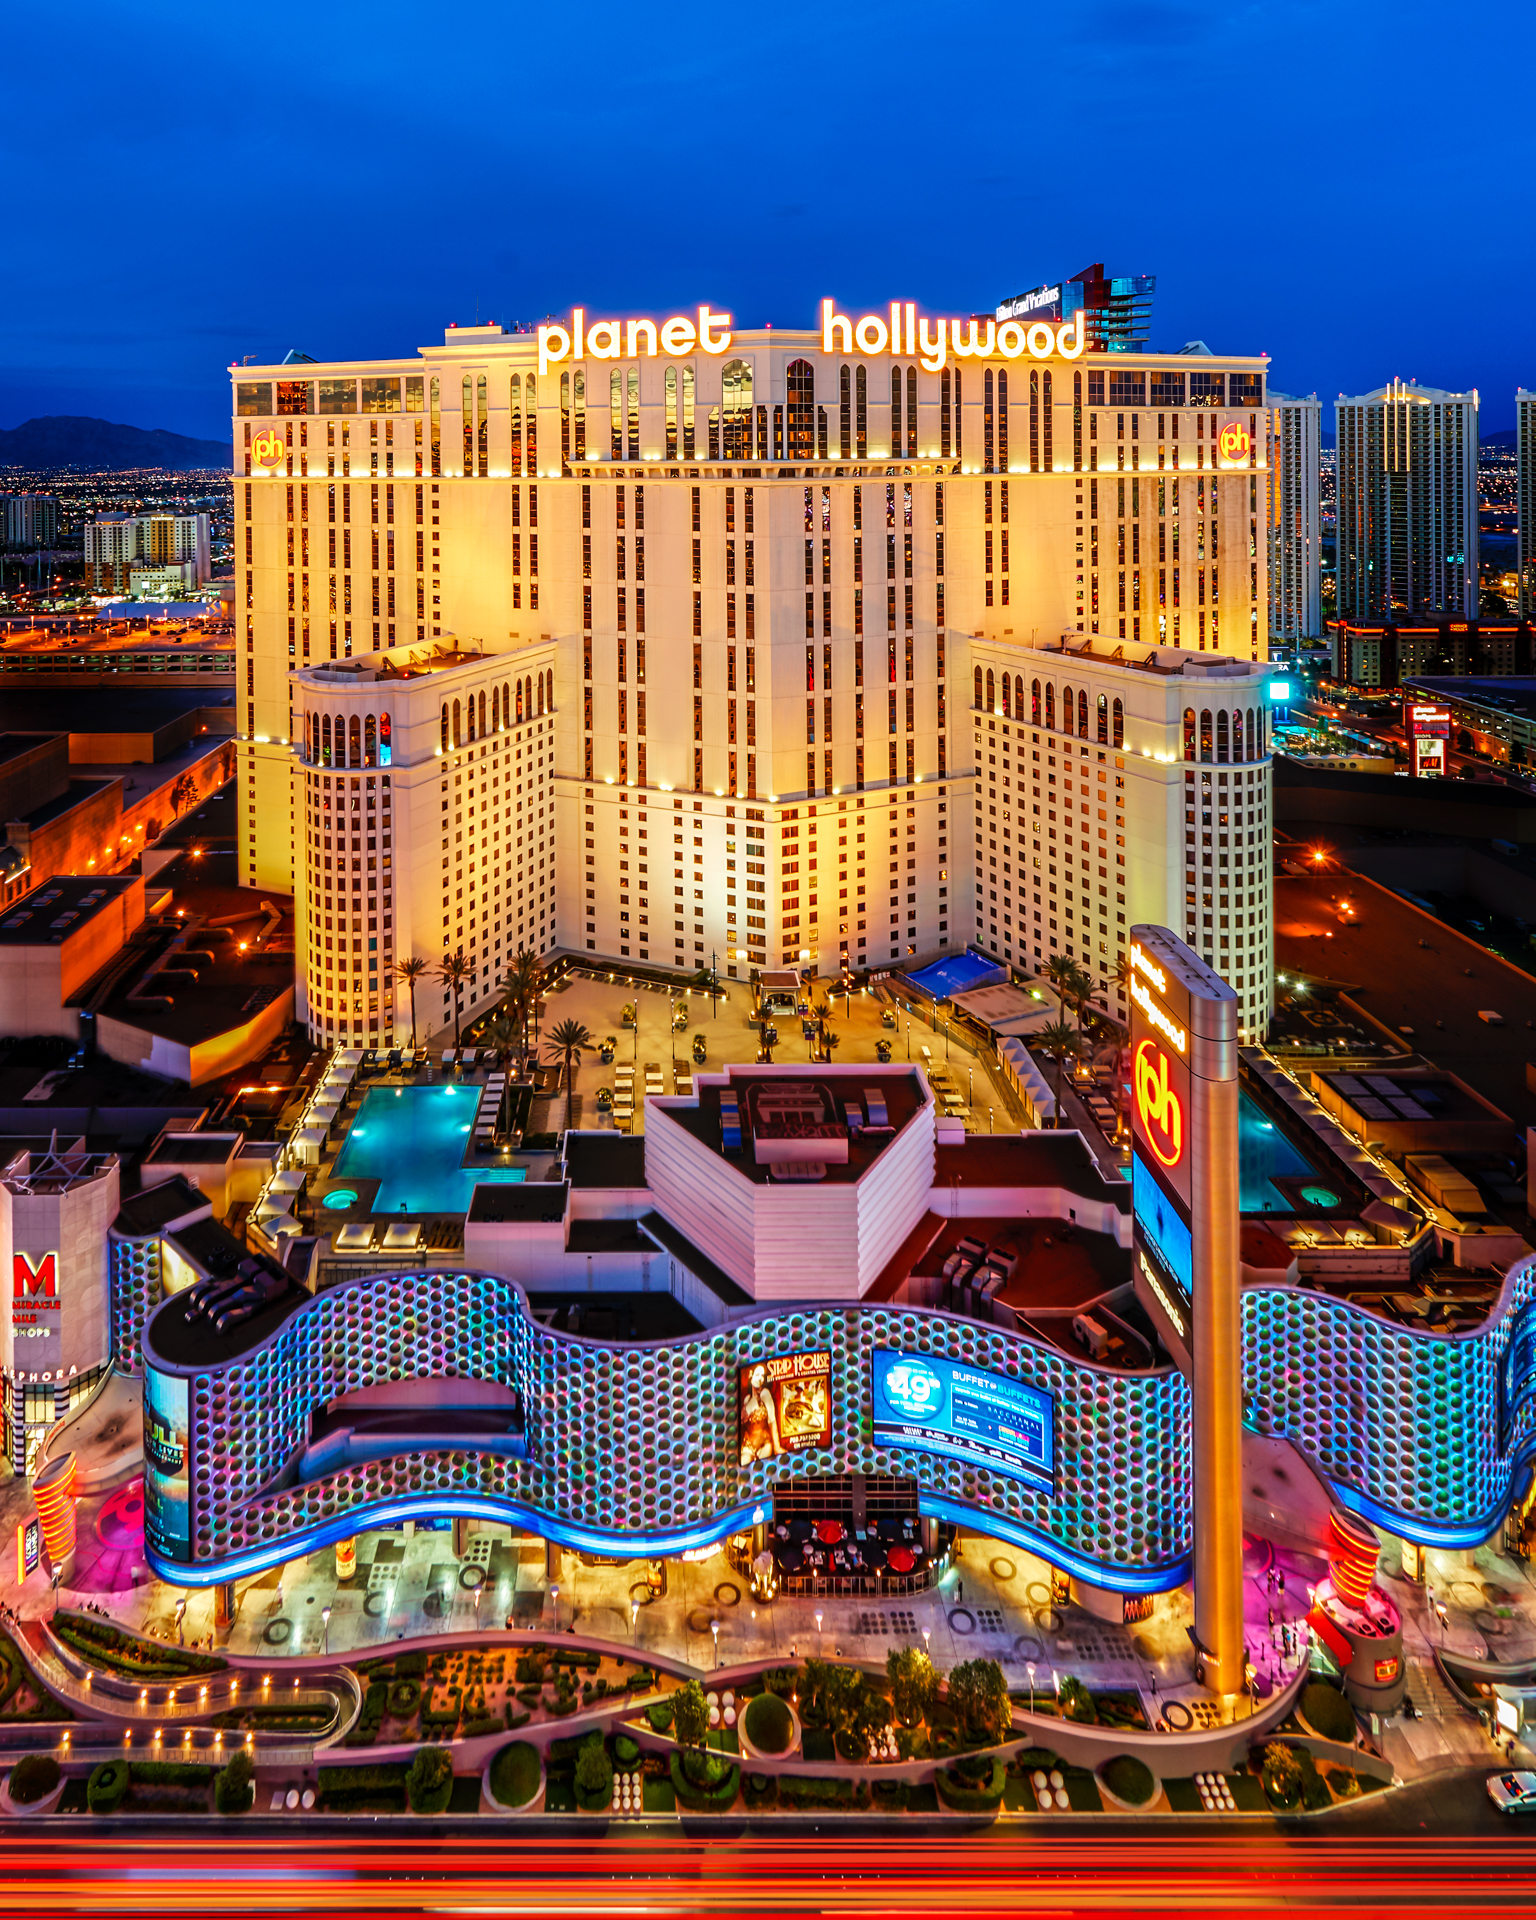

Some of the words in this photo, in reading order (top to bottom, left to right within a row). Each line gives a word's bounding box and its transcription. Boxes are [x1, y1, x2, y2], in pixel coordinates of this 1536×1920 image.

[996, 304, 1012, 323] Hilton
[1012, 294, 1029, 316] Grand
[1029, 286, 1059, 310] Vacations
[538, 306, 732, 376] planet
[823, 299, 1085, 372] hollywood
[254, 430, 283, 464] ph
[1222, 423, 1249, 458] ph
[1131, 973, 1185, 1052] hollywood
[1139, 1046, 1181, 1155] ph
[14, 1252, 59, 1297] M
[12, 1301, 61, 1310] MIRACLE
[1140, 1252, 1184, 1338] Panasonic
[12, 1314, 37, 1323] MILE
[12, 1327, 51, 1338] SHOPS
[3, 1365, 78, 1382] SEPHORA
[767, 1358, 792, 1377] STRIP
[793, 1352, 829, 1376] HOUSE
[952, 1370, 990, 1389] BUFFET
[988, 1406, 1040, 1431] BACCHANAL
[158, 1444, 184, 1458] LIVES
